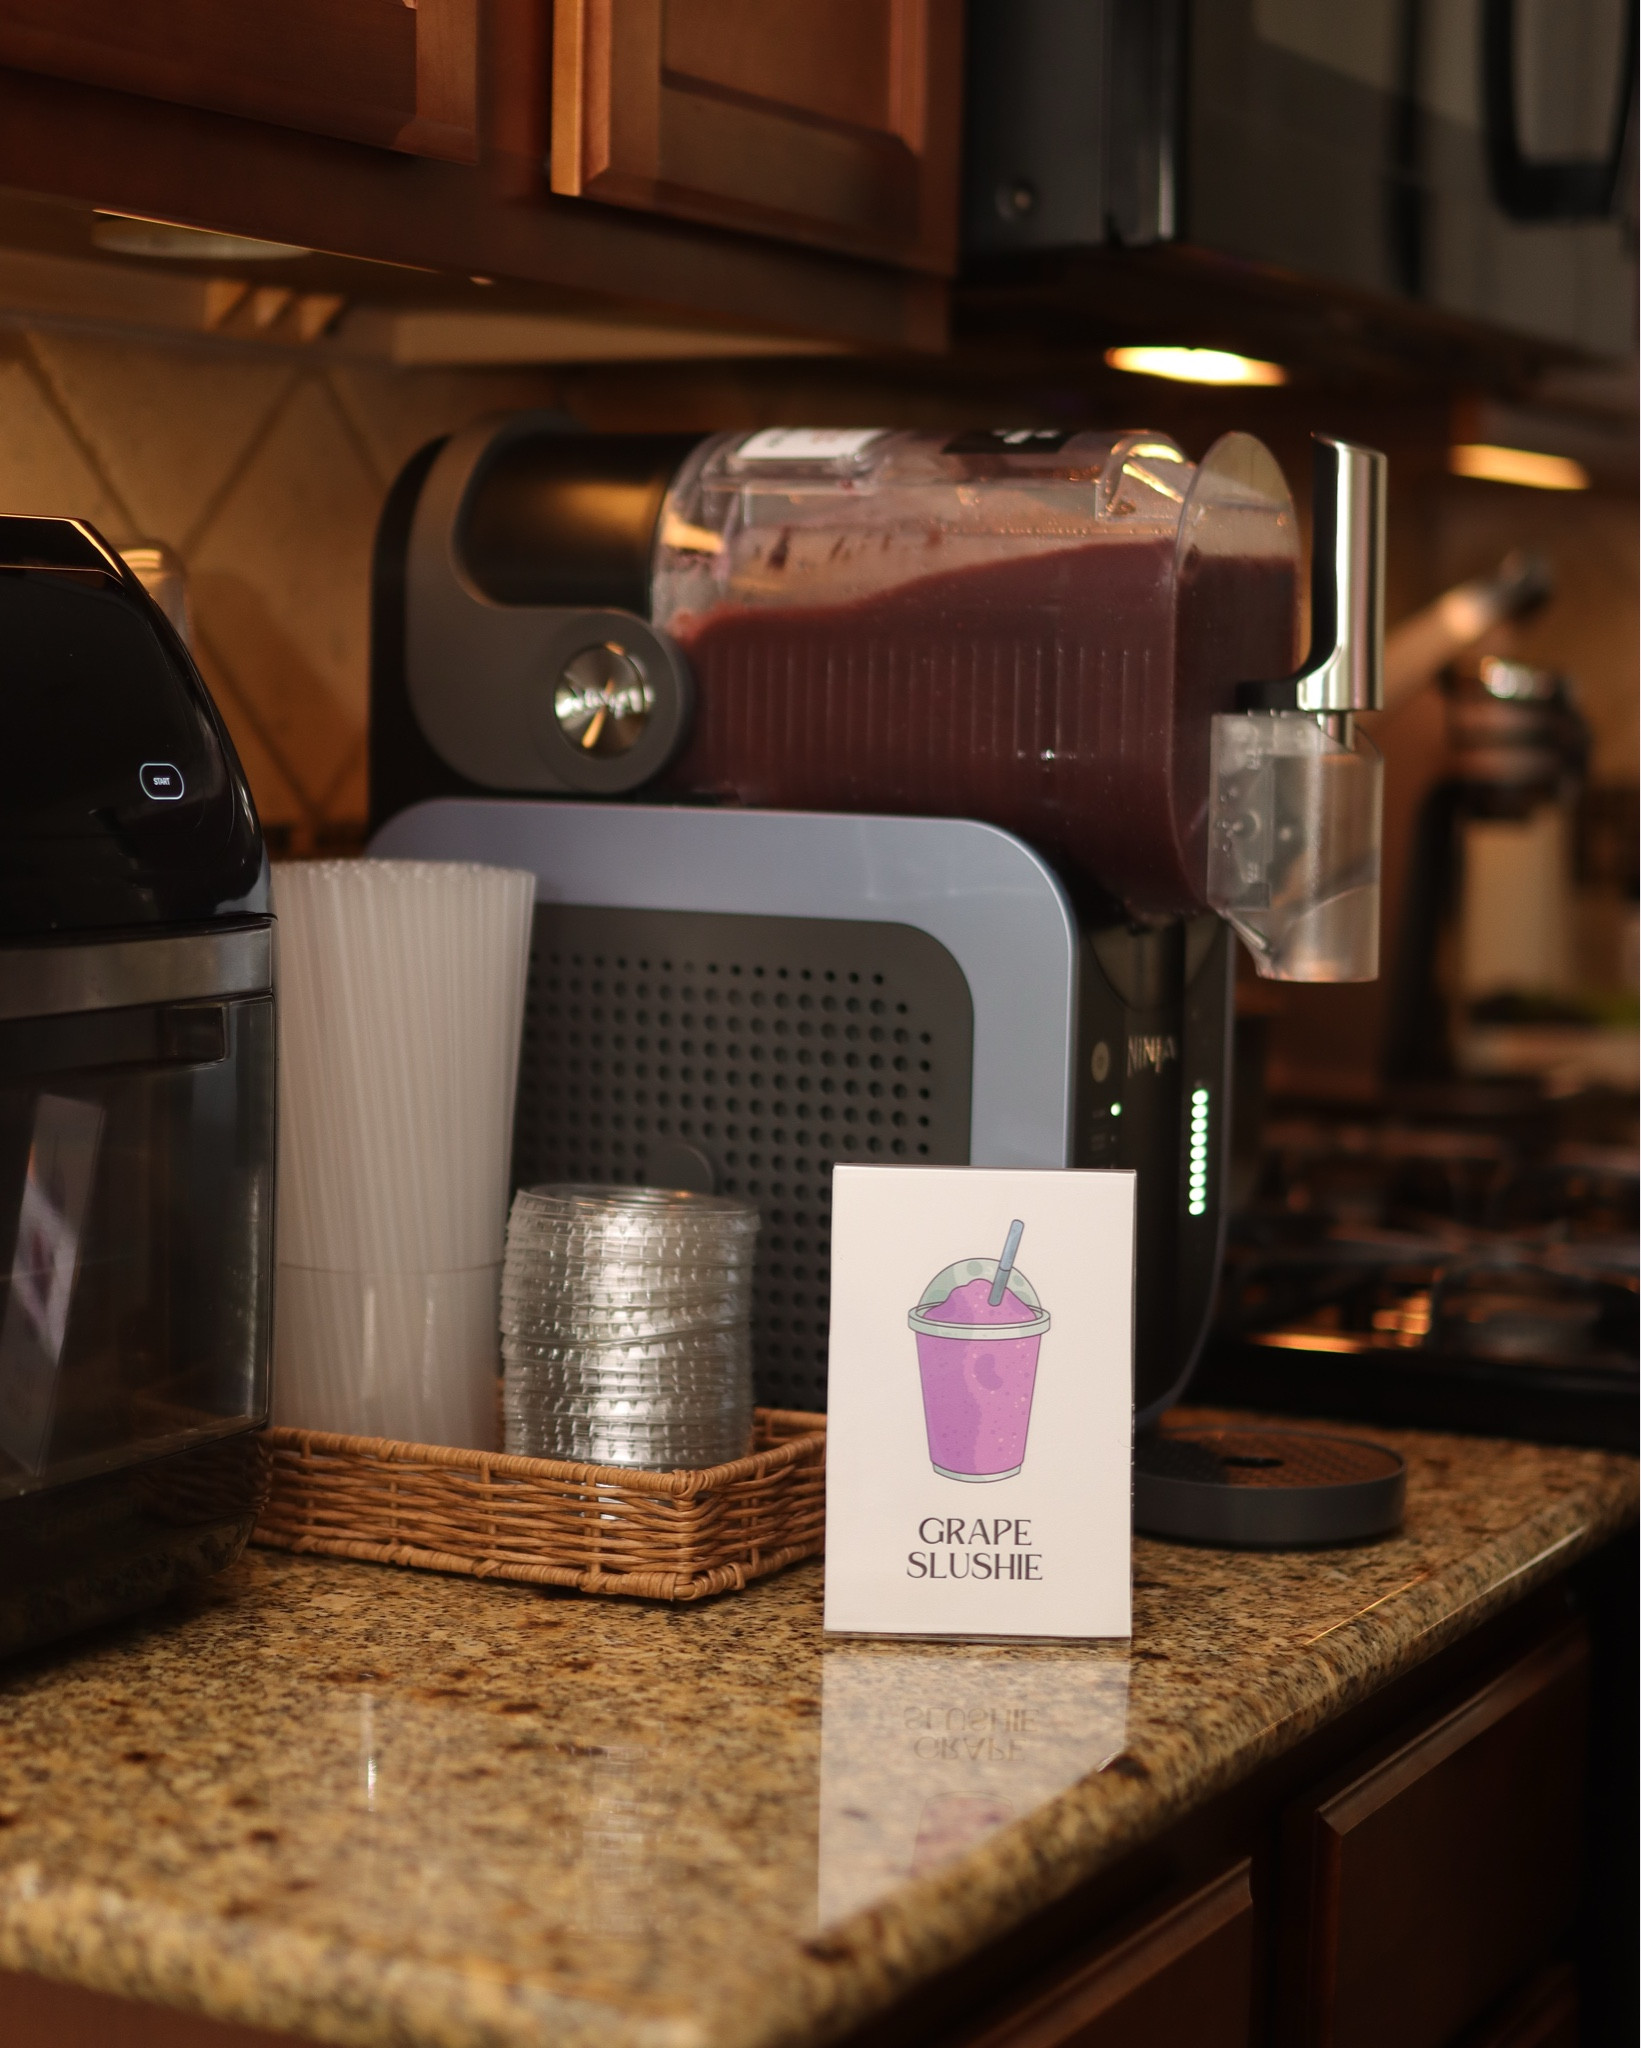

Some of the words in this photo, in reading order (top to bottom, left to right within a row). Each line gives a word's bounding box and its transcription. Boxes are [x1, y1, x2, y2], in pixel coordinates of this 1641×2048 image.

[153, 777, 171, 786] START
[919, 1517, 1032, 1546] GRAPE
[906, 1551, 1043, 1580] SLUSHIE
